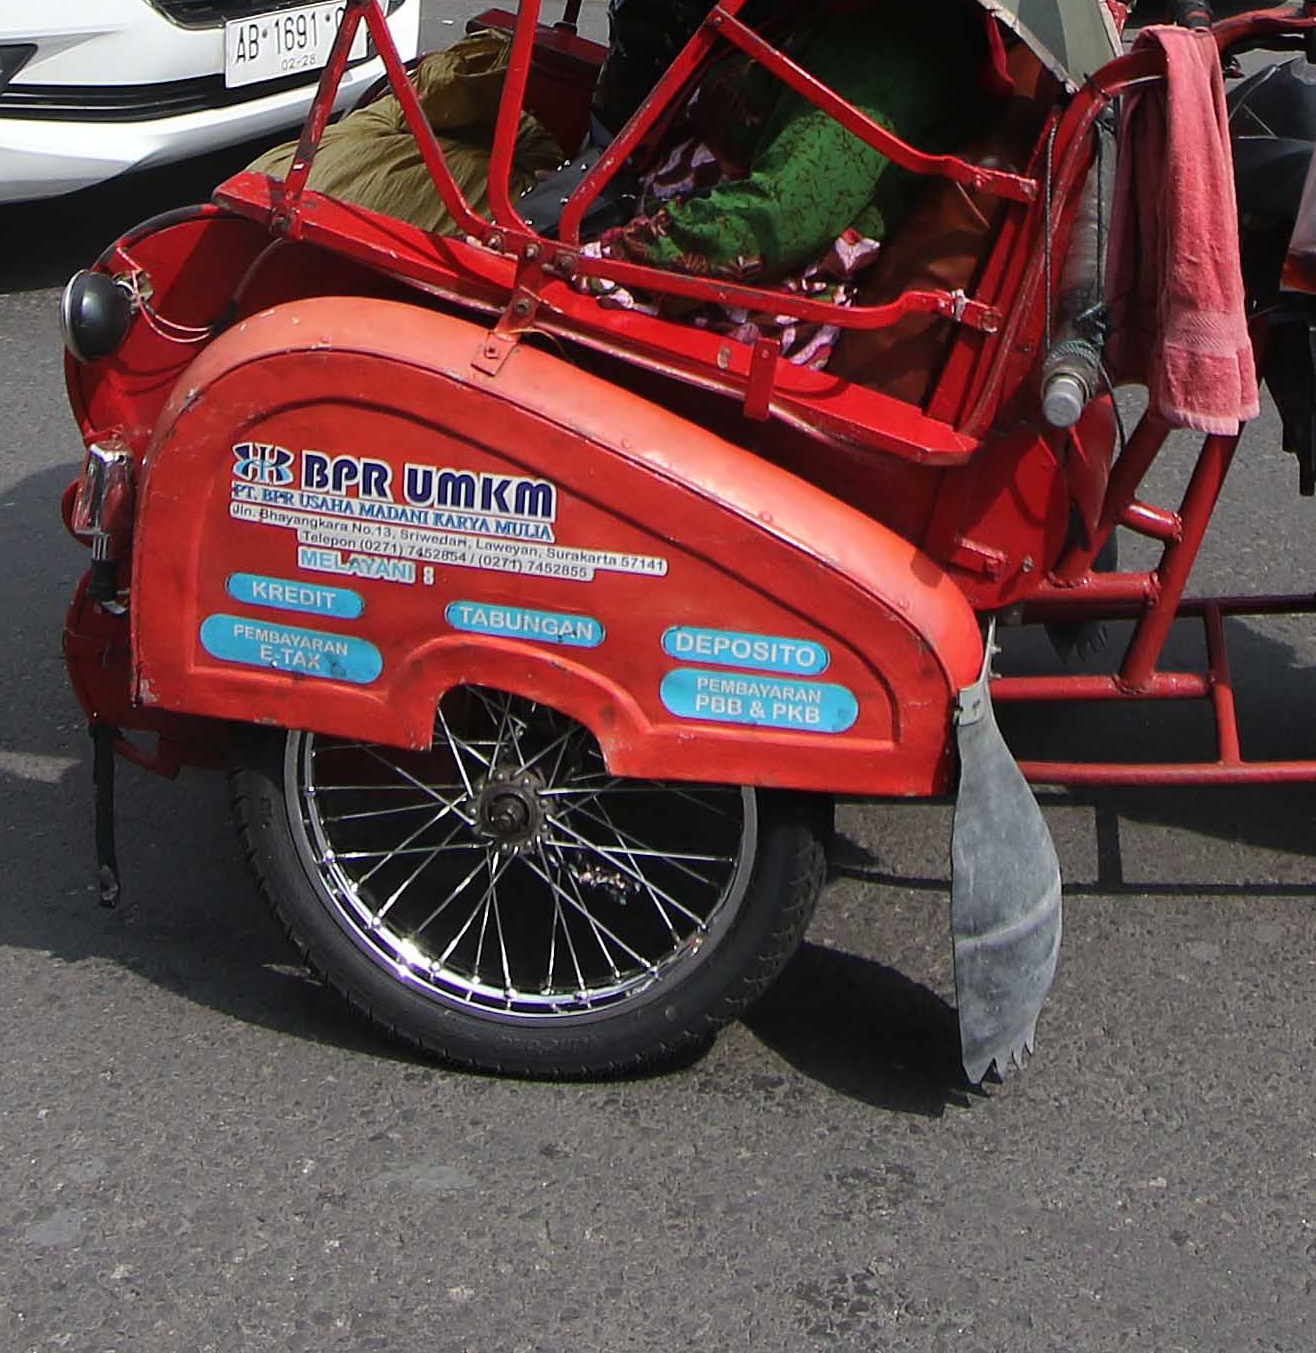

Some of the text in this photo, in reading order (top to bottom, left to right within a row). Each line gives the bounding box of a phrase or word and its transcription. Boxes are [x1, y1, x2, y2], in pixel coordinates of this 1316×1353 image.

[236, 23, 260, 64] AB
[273, 11, 318, 55] 1691
[281, 53, 317, 71] 02-28
[303, 452, 554, 519] BPR UMKM
[233, 483, 551, 540] PT. BPR USAHA MADANI KARYA MULIA
[232, 505, 256, 518] Jln.
[259, 509, 348, 532] Bhayangkara
[475, 539, 542, 559] Laweyan,
[547, 547, 617, 566] Surakarta
[621, 556, 664, 572] 57141
[302, 531, 356, 549] Telepon
[360, 539, 403, 558] (0271)
[409, 546, 467, 563] 7452854
[478, 554, 523, 574] (0271)
[528, 561, 588, 579] 7452855
[300, 548, 414, 582] MELAYANI
[252, 581, 337, 609] KREDIT
[234, 624, 348, 656] PEMBAYARAN
[460, 606, 593, 640] TABUNGAN
[260, 645, 321, 670] E-TAX
[675, 632, 815, 667] DEPOSITO
[697, 677, 821, 704] PEMBAYARAN
[696, 694, 821, 724] PBB & PKB
